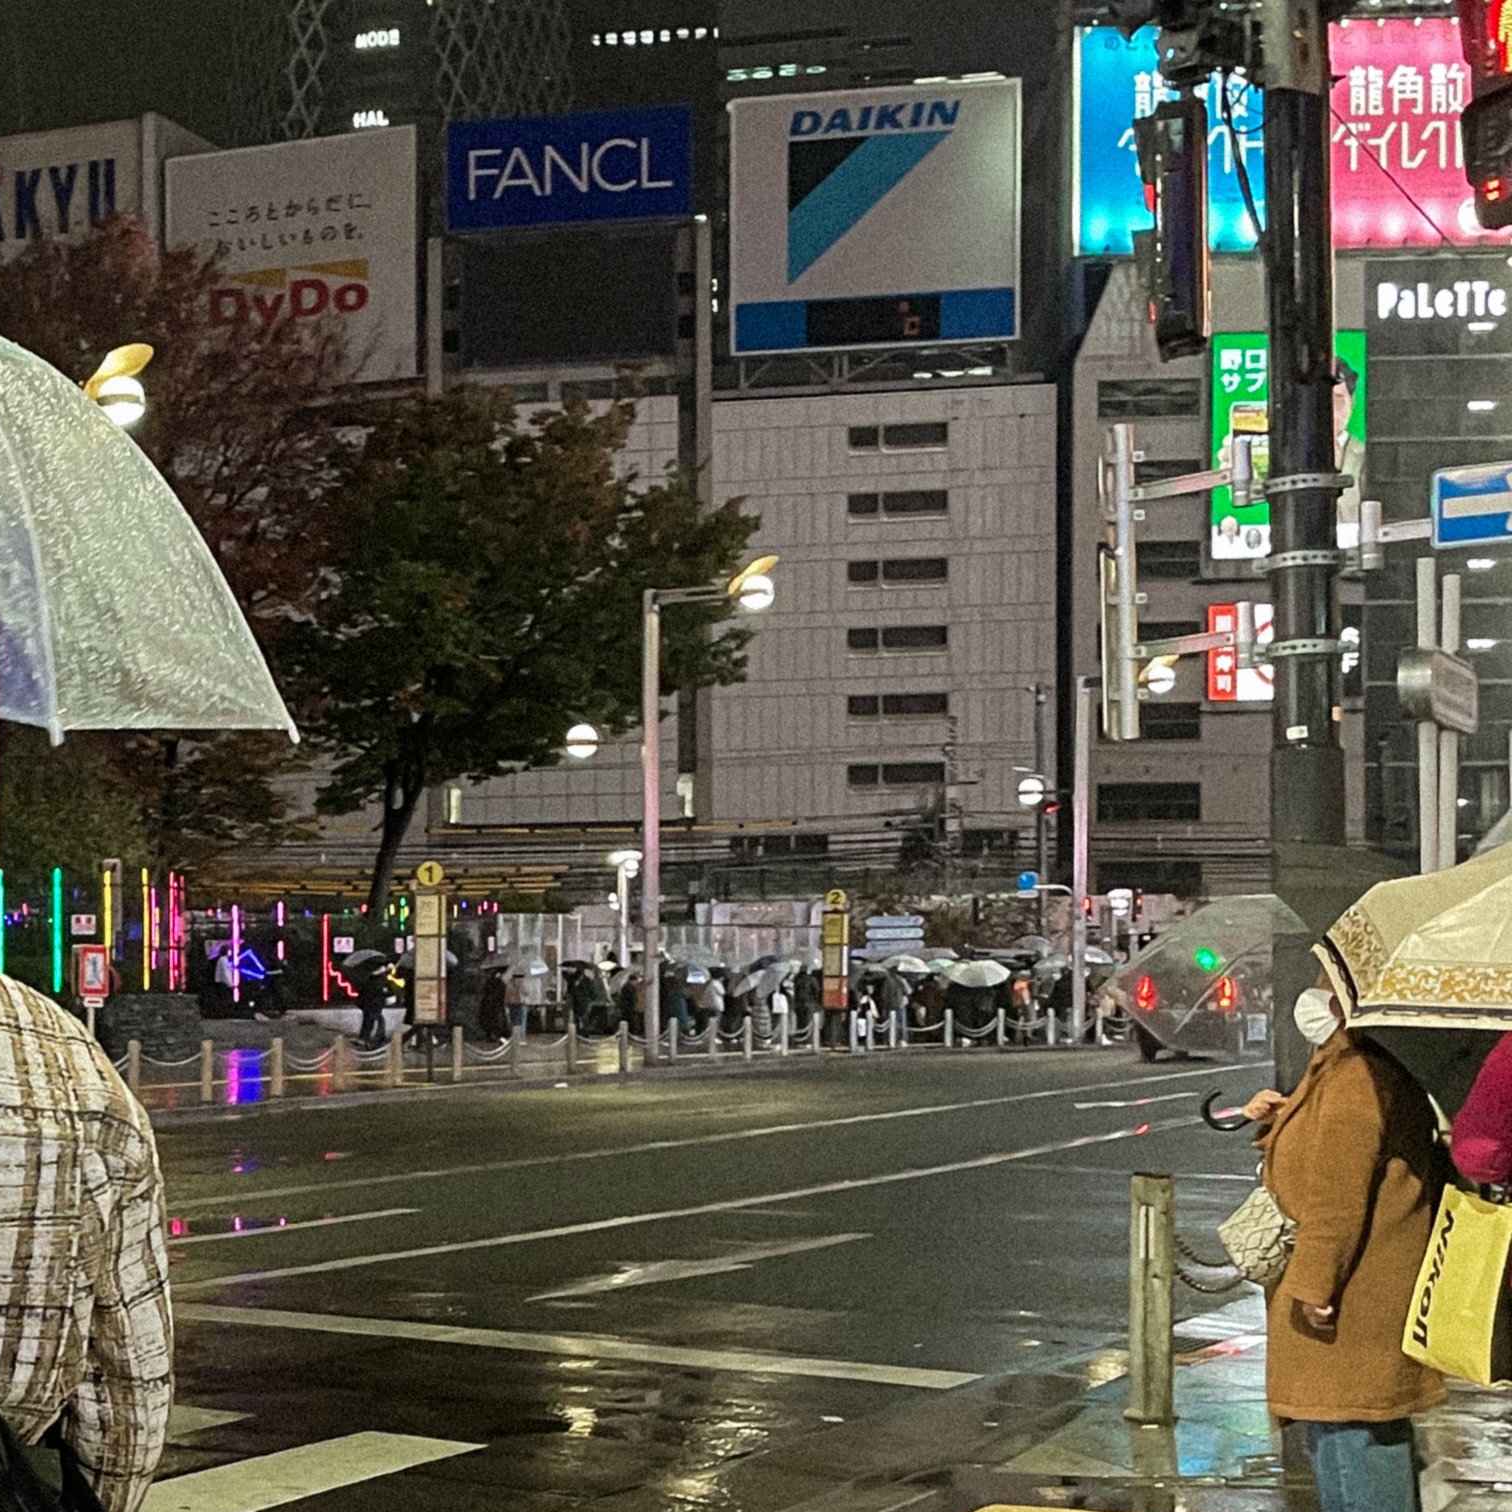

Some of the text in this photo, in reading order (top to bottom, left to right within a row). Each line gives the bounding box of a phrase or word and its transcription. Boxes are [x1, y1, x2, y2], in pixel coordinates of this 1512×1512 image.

[1348, 62, 1466, 116] 龍角散
[353, 110, 390, 128] HAL
[790, 100, 961, 136] DAIKIN
[468, 137, 675, 200] FANCL
[209, 278, 369, 333] DyDo
[424, 865, 434, 883] 1
[830, 892, 841, 905] 2
[1412, 1208, 1454, 1349] Nikon
